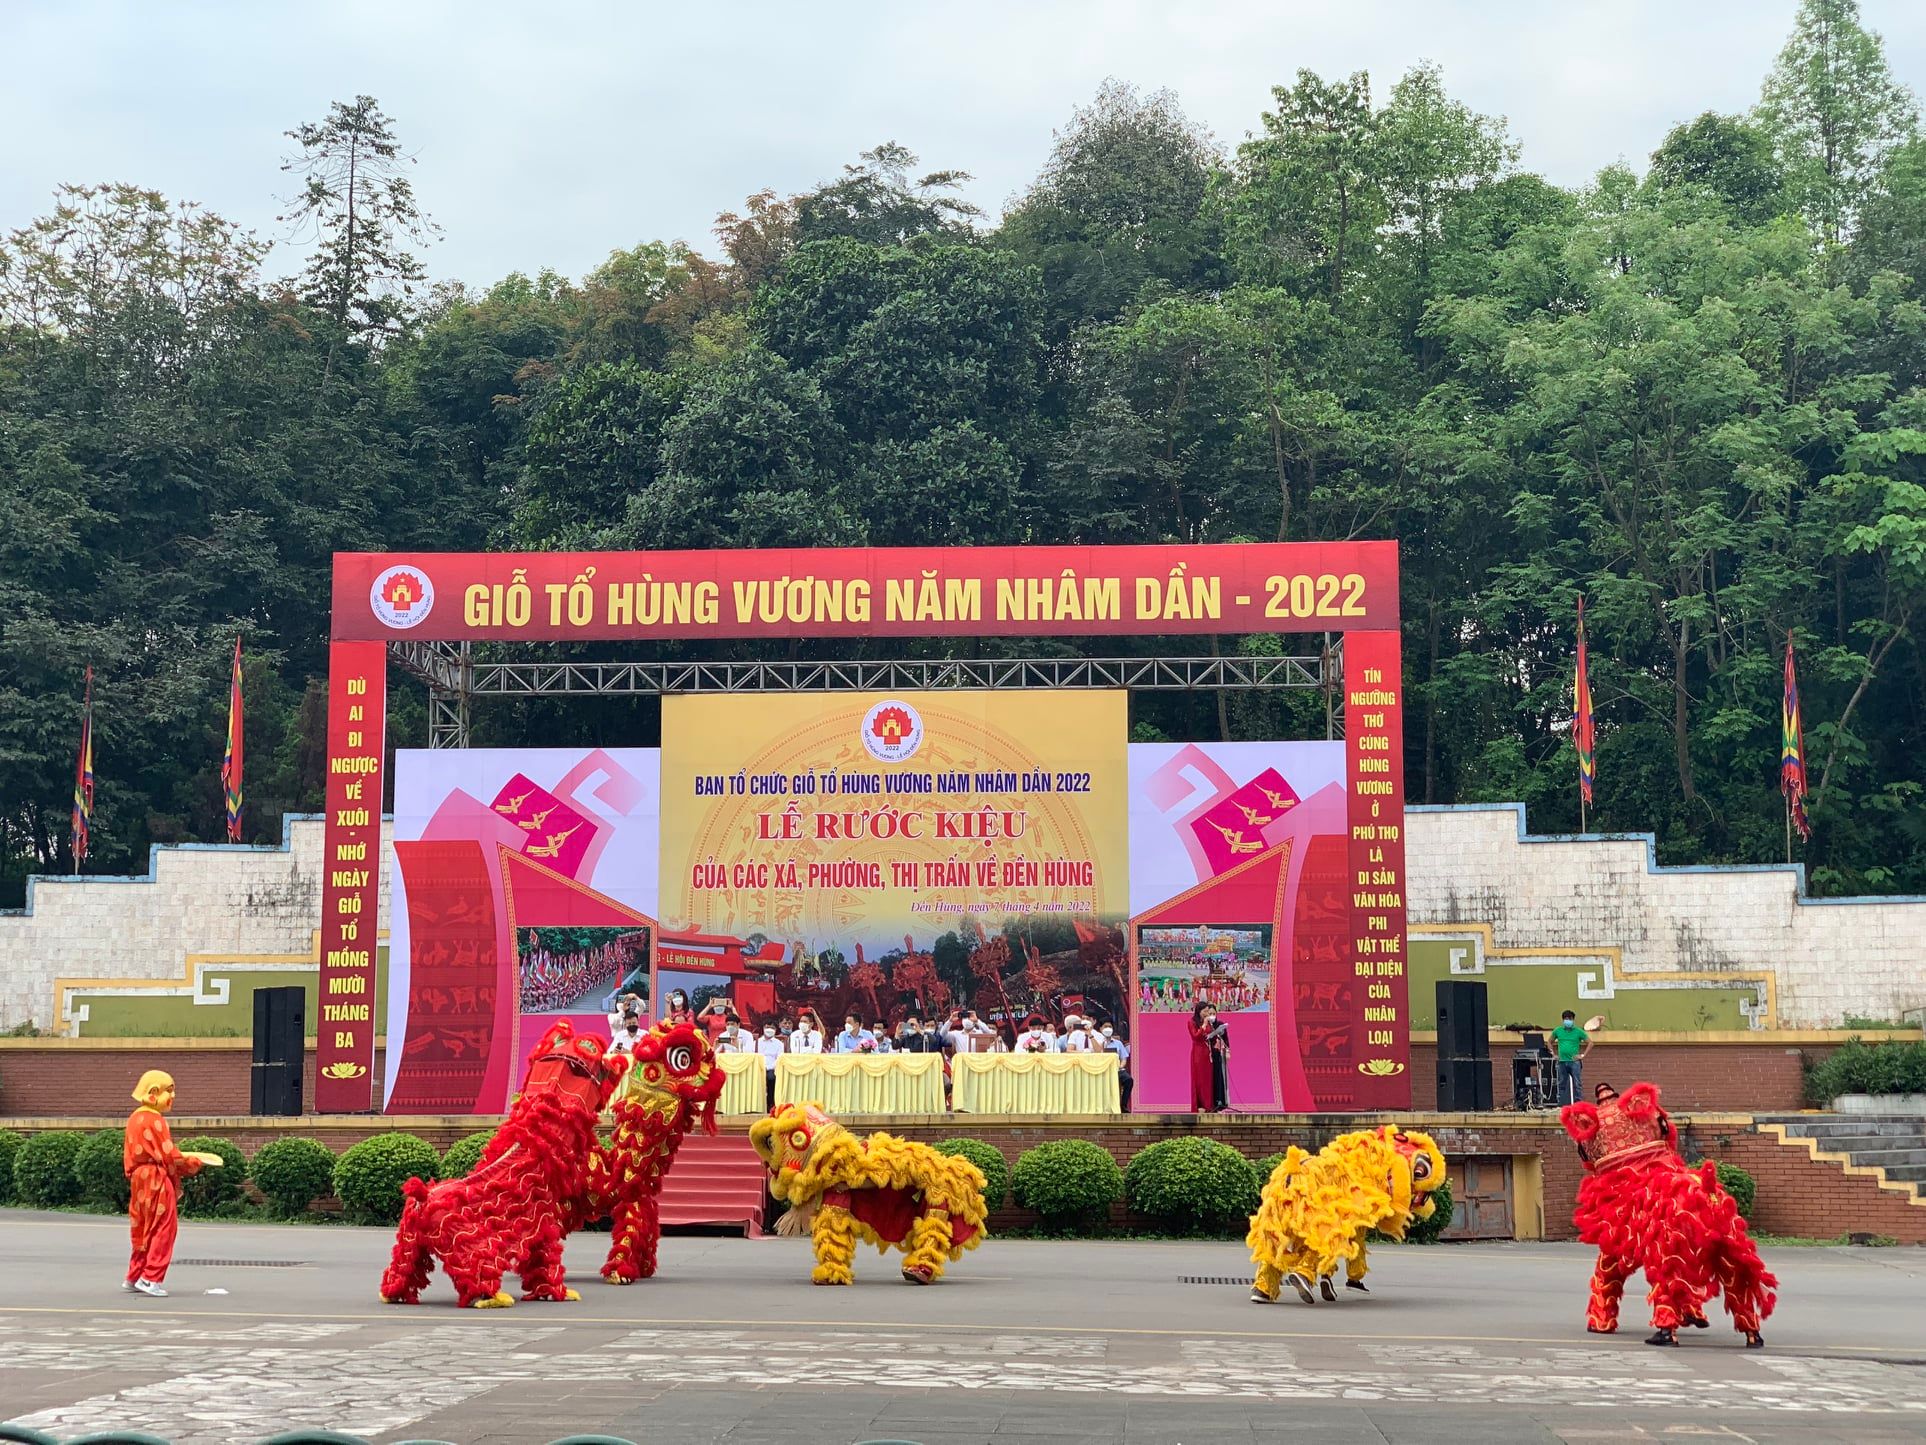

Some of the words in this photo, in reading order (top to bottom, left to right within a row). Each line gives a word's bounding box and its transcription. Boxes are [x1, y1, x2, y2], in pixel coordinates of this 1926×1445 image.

[464, 568, 532, 627] GIỖ
[545, 566, 597, 627] TỔ
[607, 573, 719, 625] HÙNG
[733, 575, 871, 624] VƯƠNG
[885, 569, 982, 621] NĂM
[996, 568, 1121, 621] NHÂM
[1135, 561, 1221, 620] DẦN
[1235, 595, 1251, 605] -
[1264, 573, 1367, 618] 2022
[1364, 667, 1382, 683] TÍN
[348, 676, 366, 695] DÙ
[1351, 689, 1395, 705] NGƯỠNG
[349, 706, 362, 720] AI
[1363, 711, 1384, 728] THỜ
[348, 732, 362, 747] ĐI
[1359, 734, 1388, 750] CÚNG
[332, 756, 378, 776] NGƯỢC
[1359, 757, 1389, 773] HÙNG
[346, 779, 363, 800] VỀ
[695, 776, 724, 796] BAN
[729, 768, 747, 795] TỔ
[750, 771, 787, 795] CHỨC
[792, 768, 816, 794] GIỖ
[820, 766, 838, 794] TỔ
[841, 771, 880, 794] HÙNG
[885, 772, 932, 793] VƯƠNG
[937, 770, 970, 793] NĂM
[975, 769, 1017, 792] NHÂM
[1022, 766, 1051, 792] DẦN
[1056, 773, 1091, 792] 2022
[1357, 781, 1393, 795] VƯƠNG
[337, 807, 369, 826] XUÔI
[1371, 800, 1379, 817] Ở
[758, 800, 803, 839] LỄ
[814, 804, 923, 839] RƯỚC
[934, 804, 1027, 847] KIỆU
[1353, 823, 1375, 840] PHÚ
[1378, 826, 1398, 843] THỌ
[337, 842, 366, 861] NHỚ
[1369, 846, 1383, 862] LÀ
[332, 868, 369, 888] NGÀY
[692, 855, 728, 889] CỦA
[733, 859, 768, 889] CÁC
[774, 859, 803, 891] XÃ,
[808, 857, 886, 891] PHƯỜNG,
[891, 862, 918, 893] THỊ
[924, 854, 970, 887] TRẤN
[976, 855, 997, 887] VỀ
[1003, 854, 1038, 887] ĐỀN
[1044, 856, 1093, 887] HÙNG
[1358, 871, 1369, 885] DI
[1372, 867, 1395, 885] SẢN
[338, 892, 361, 914] GIỖ
[1067, 901, 1091, 911] 2022
[1354, 892, 1376, 908] VĂN
[1379, 891, 1401, 907] HÓA
[340, 918, 358, 940] TỔ
[1369, 917, 1387, 930] PHI
[1357, 936, 1377, 955] VẬT
[1380, 933, 1400, 953] THỂ
[327, 946, 369, 967] MỒNG
[1355, 962, 1373, 978] ĐẠI
[1377, 959, 1403, 978] DIỆN
[329, 975, 365, 994] MƯỜI
[1369, 981, 1390, 998] CỦA
[324, 1002, 369, 1021] THÁNG
[1364, 1005, 1395, 1021] NHÂN
[335, 1032, 354, 1048] BA
[1369, 1030, 1392, 1047] LOẠI
